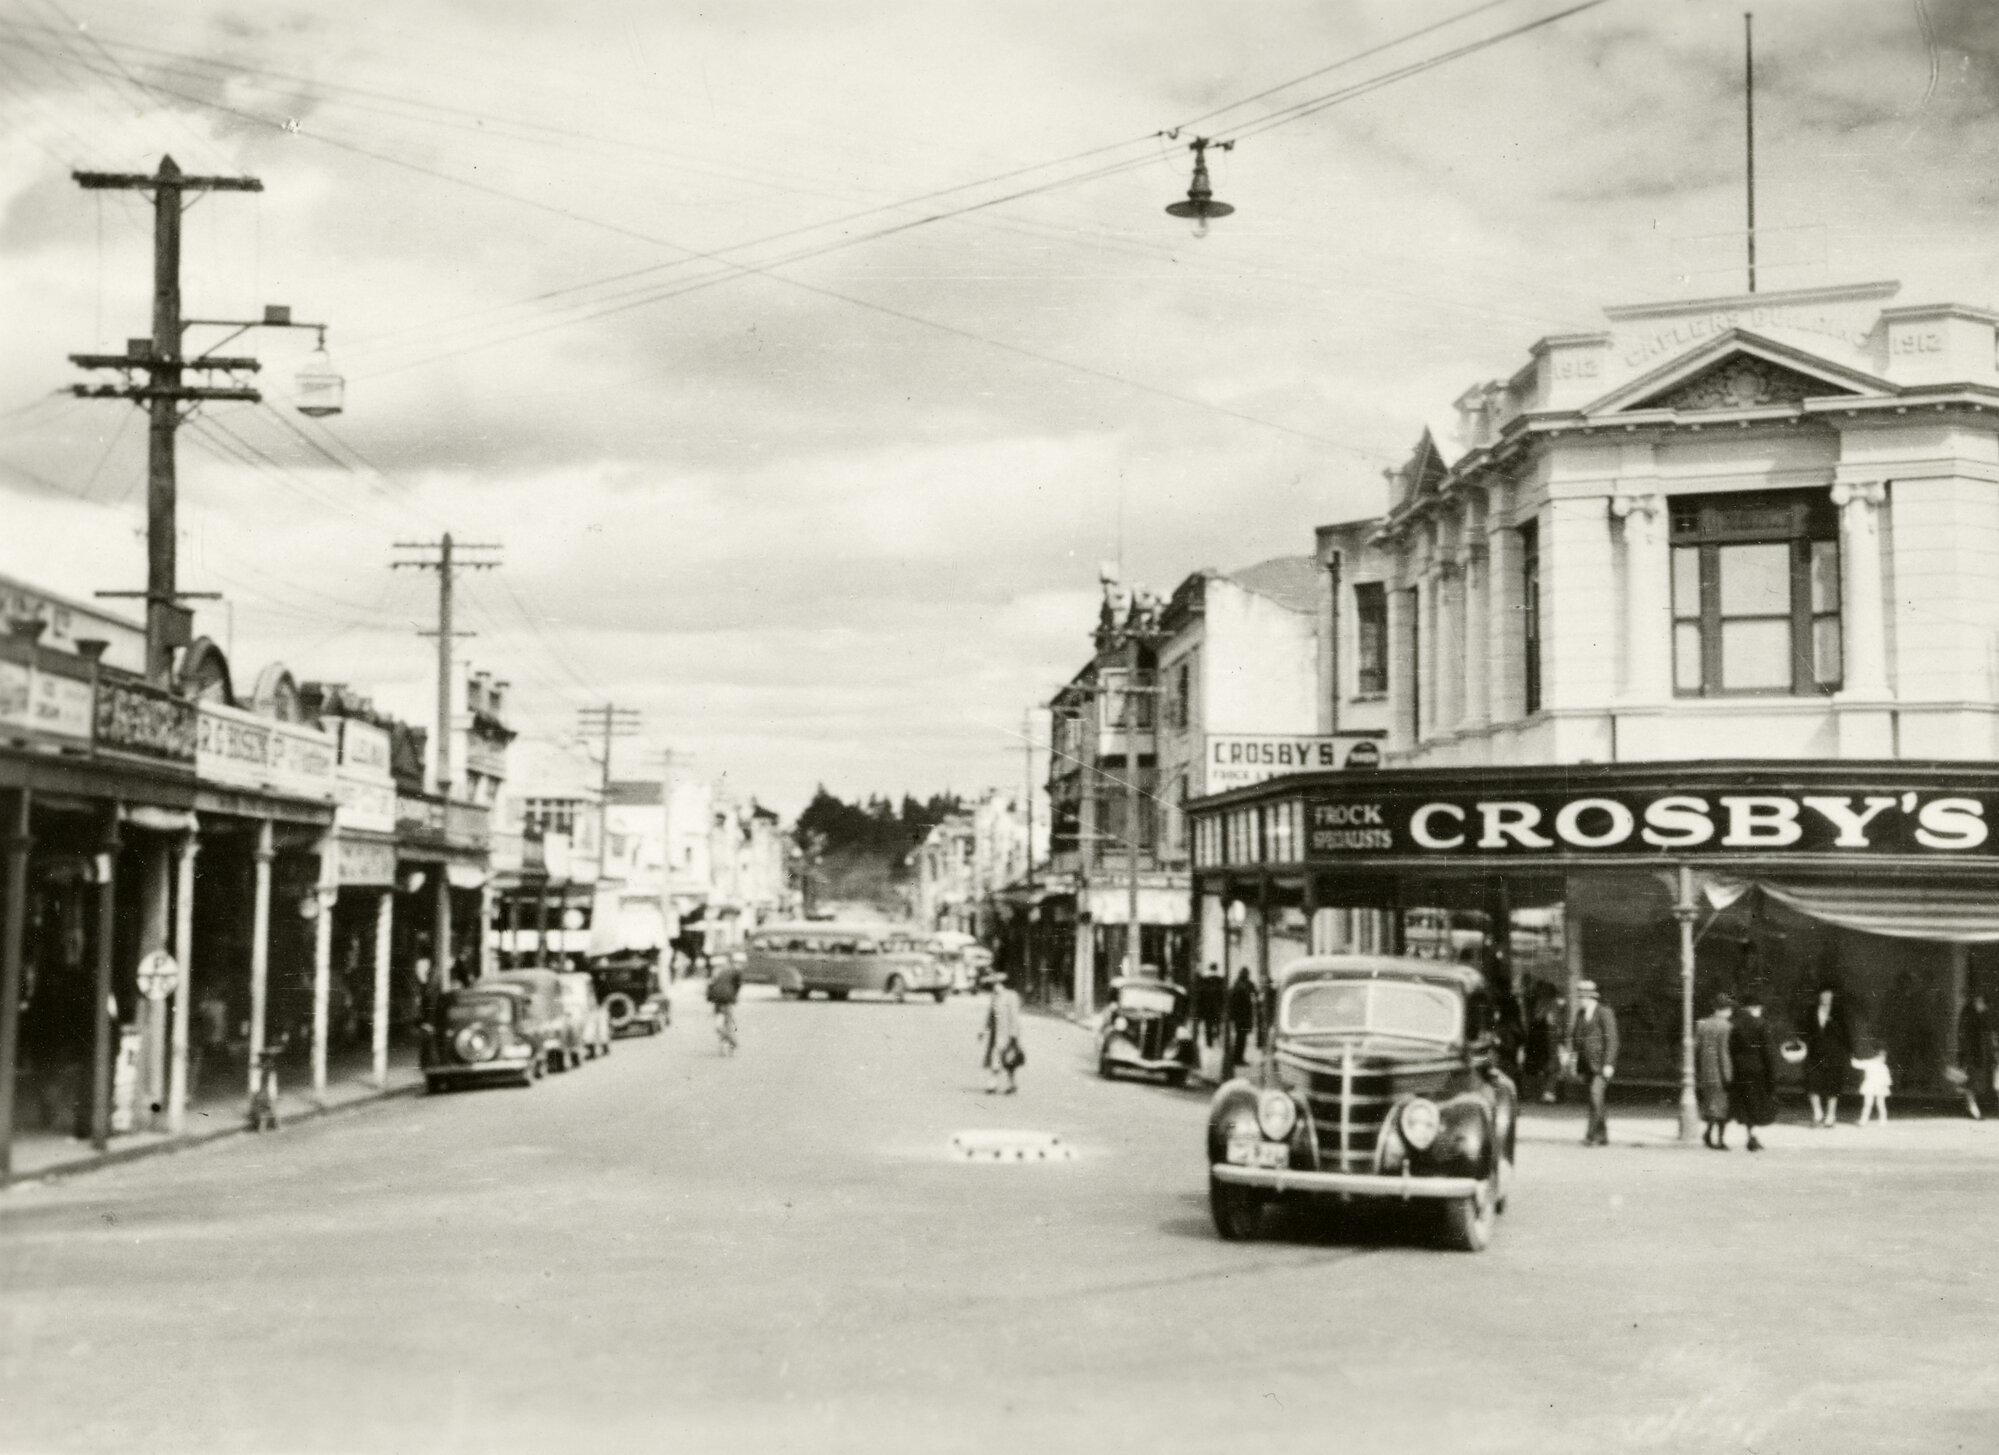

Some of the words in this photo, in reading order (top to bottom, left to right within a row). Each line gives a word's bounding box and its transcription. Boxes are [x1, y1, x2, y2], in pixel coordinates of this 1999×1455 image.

[1893, 331, 1942, 354] 1912
[1215, 743, 1333, 765] CROSBY'S
[1316, 804, 1383, 825] FROCK
[1408, 792, 1988, 849] CROSBY'S
[1313, 829, 1393, 849] SPECIALISTS
